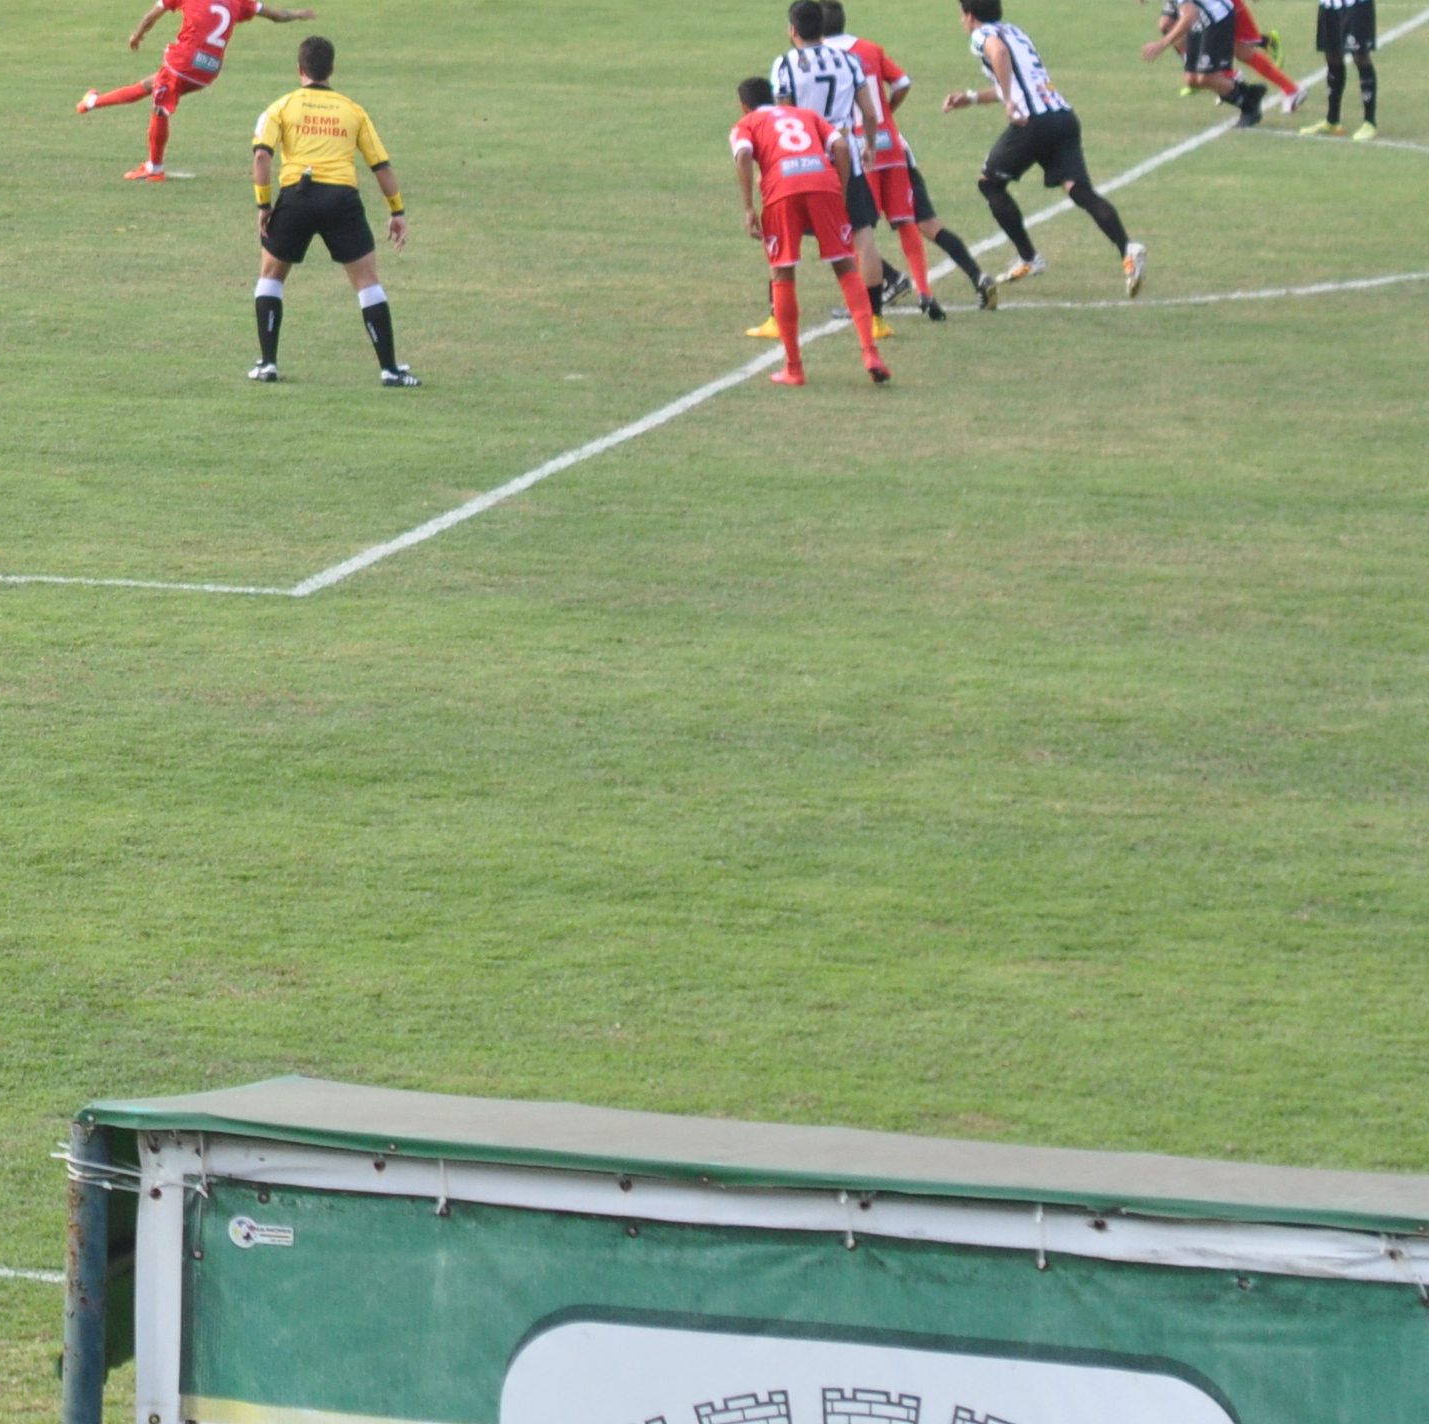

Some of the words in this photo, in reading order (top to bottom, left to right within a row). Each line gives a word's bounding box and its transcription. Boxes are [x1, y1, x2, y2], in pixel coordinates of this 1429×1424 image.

[206, 4, 232, 49] 2
[815, 74, 837, 117] 7
[296, 124, 348, 138] TOSHIBA
[304, 115, 340, 125] SEMP
[774, 117, 812, 152] 8
